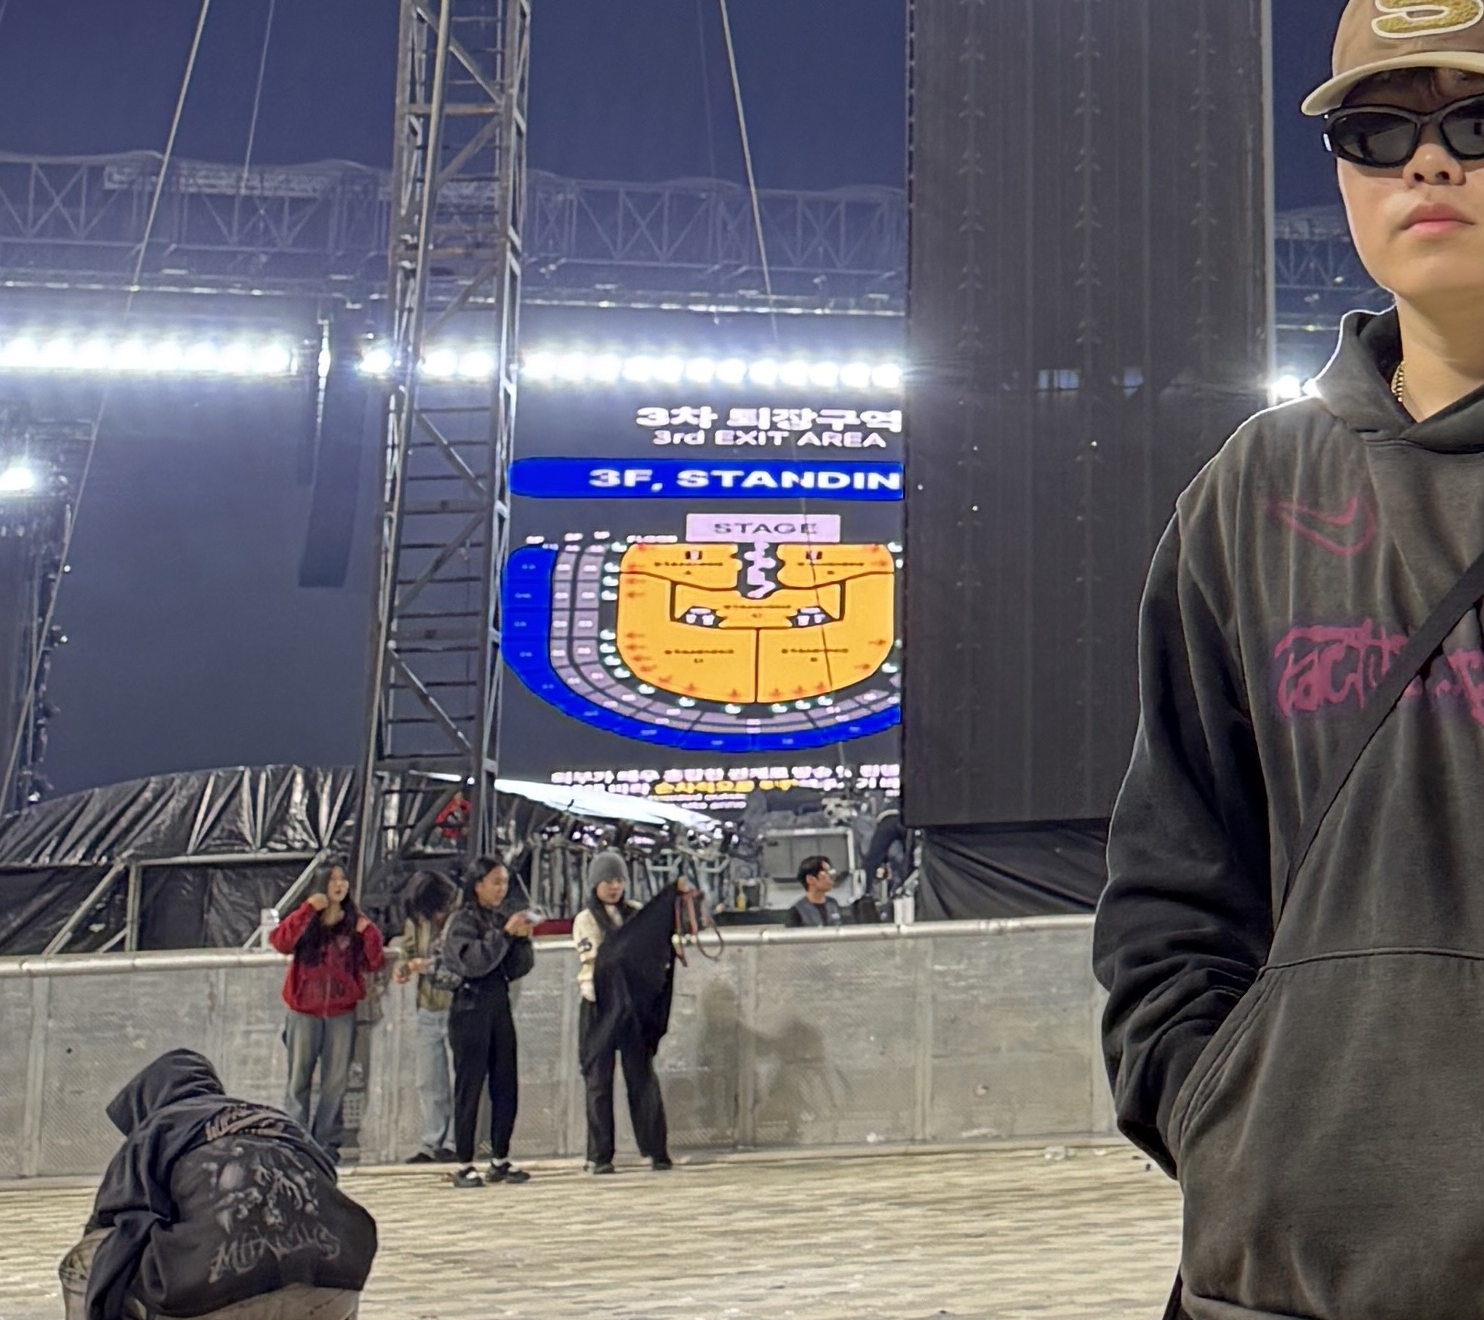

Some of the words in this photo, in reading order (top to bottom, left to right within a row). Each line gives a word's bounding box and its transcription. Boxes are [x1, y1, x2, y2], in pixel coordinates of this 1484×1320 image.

[636, 406, 718, 429] 3차
[726, 406, 902, 432] 퇴장구역
[653, 429, 706, 445] 3rd
[714, 430, 789, 446] EXIT
[796, 431, 887, 448] AREA
[589, 468, 664, 493] 3F,
[677, 469, 900, 490] STANDIN
[714, 522, 817, 534] STAGE
